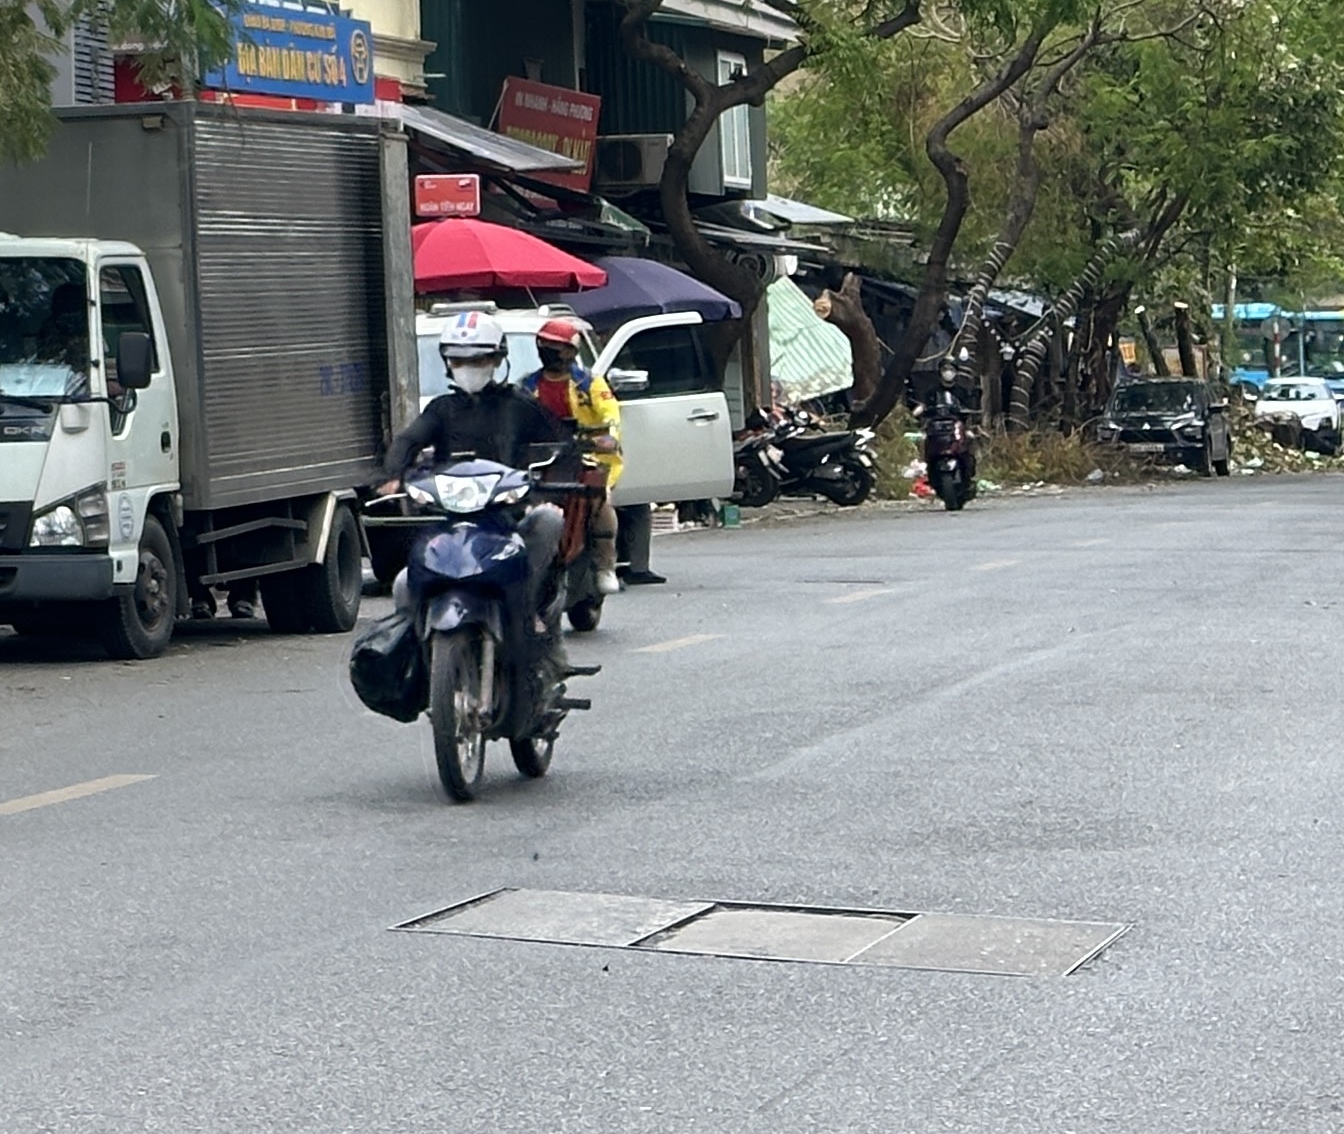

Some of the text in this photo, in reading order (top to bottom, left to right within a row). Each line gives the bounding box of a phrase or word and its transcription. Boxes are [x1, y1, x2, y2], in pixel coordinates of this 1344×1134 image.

[258, 37, 281, 80] BÀN
[281, 41, 305, 82] DÂN
[306, 50, 322, 84] CƯ
[323, 43, 338, 86] SỐ
[338, 56, 347, 88] 4
